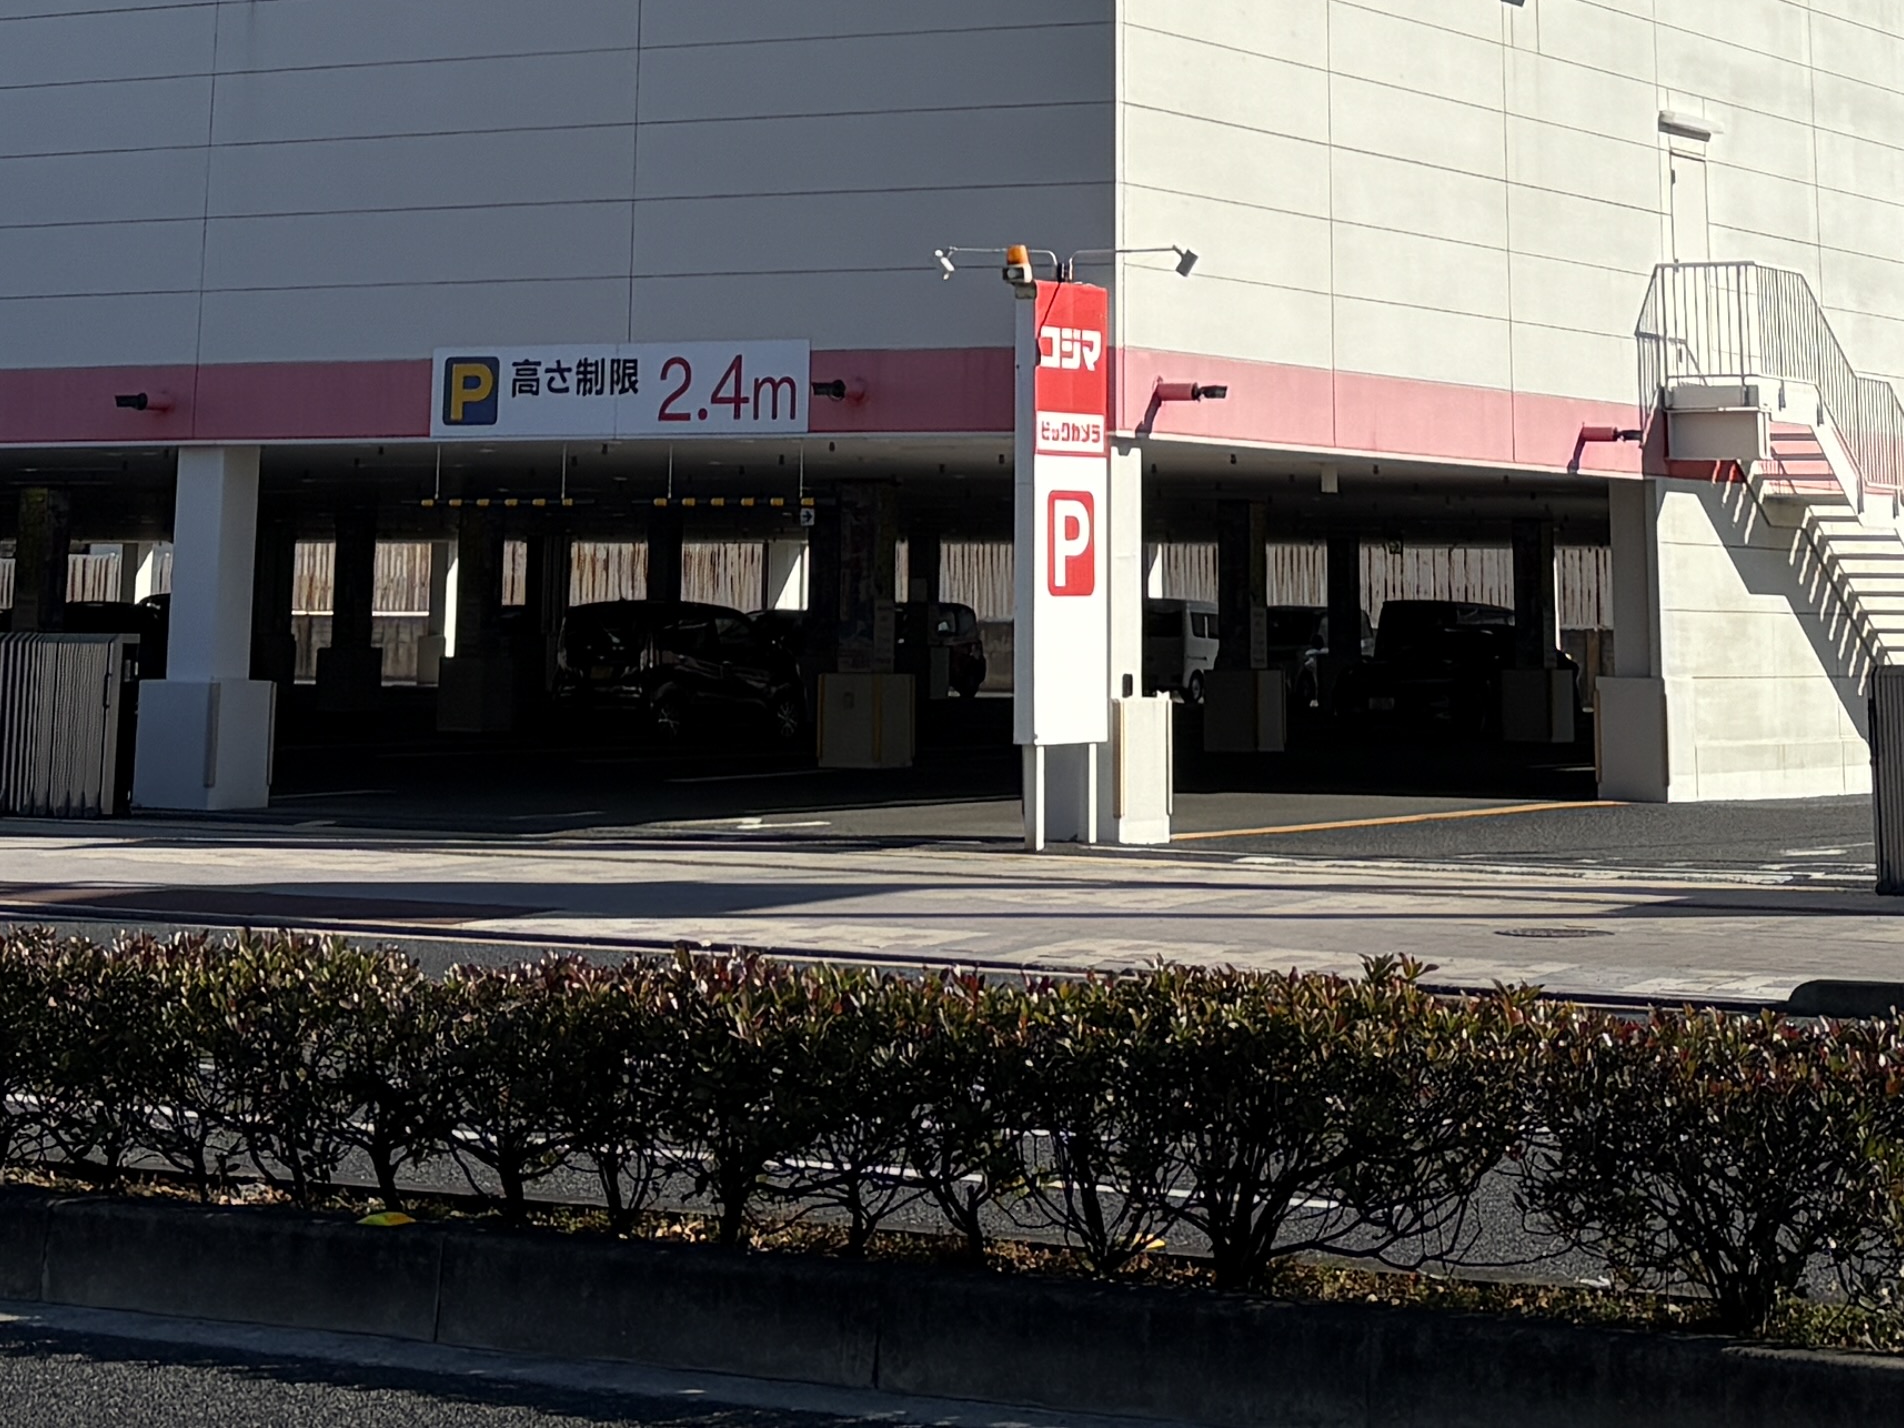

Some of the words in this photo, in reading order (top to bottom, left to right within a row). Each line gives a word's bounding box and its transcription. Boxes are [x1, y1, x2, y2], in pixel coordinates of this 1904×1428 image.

[1039, 325, 1102, 372] コジマ
[450, 365, 494, 418] P
[510, 356, 641, 400] 高さ制限
[658, 354, 799, 424] 2.4m
[1041, 420, 1101, 444] ビックカメラ
[1055, 501, 1092, 587] P
